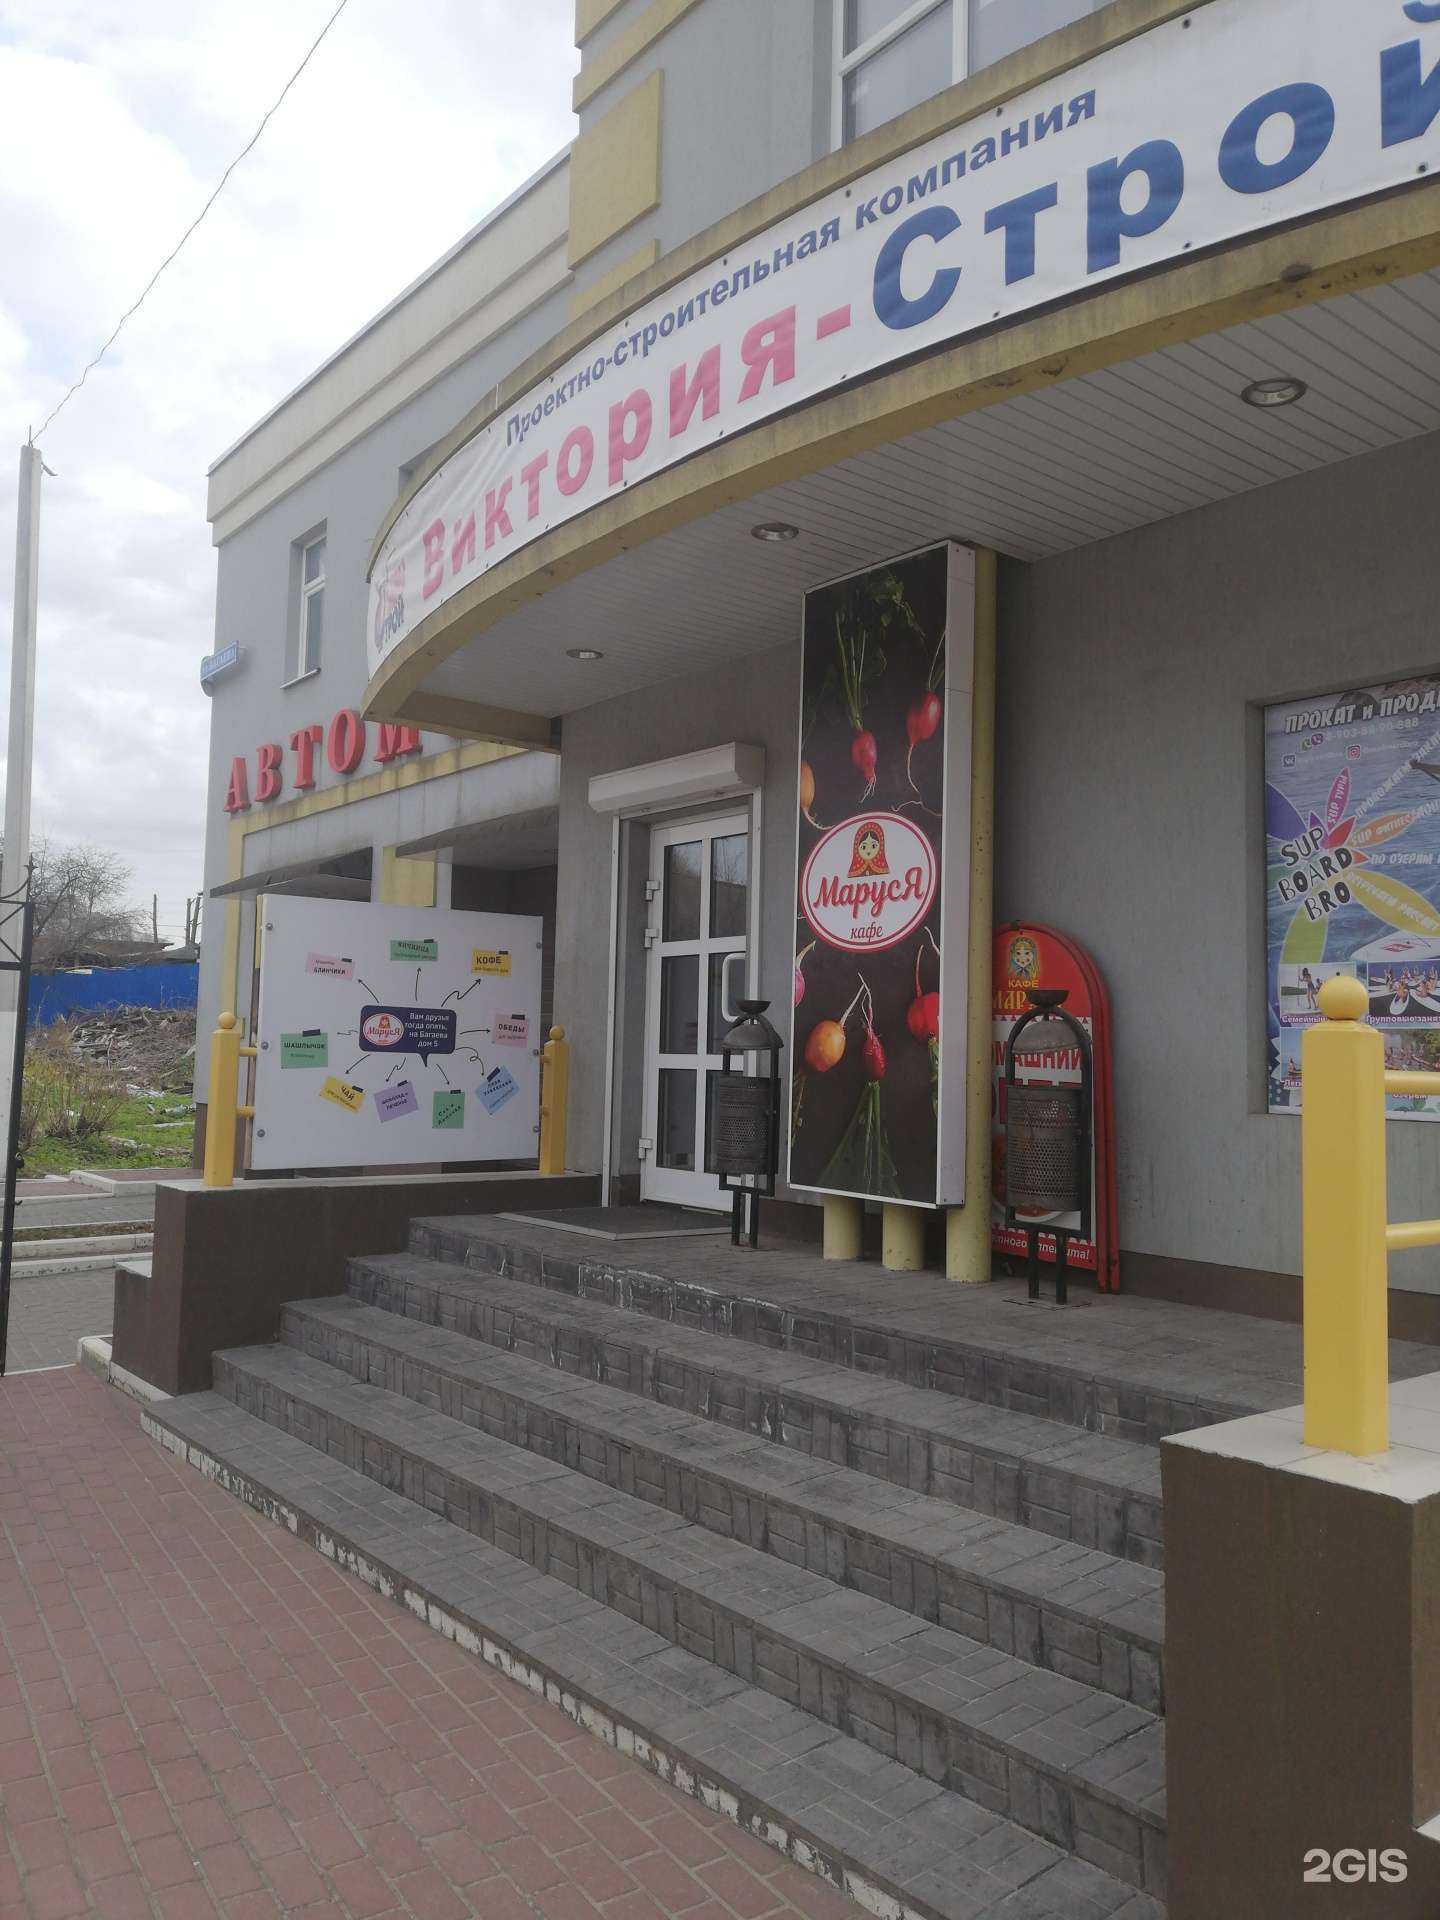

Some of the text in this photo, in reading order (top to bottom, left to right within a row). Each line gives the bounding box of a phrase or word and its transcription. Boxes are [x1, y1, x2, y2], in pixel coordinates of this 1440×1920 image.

[505, 89, 1096, 446] Проектно-строительная компания
[1285, 704, 1357, 733] ПРОКАТ
[1379, 690, 1440, 716] ПРОД
[1280, 827, 1324, 867] SUP
[1278, 847, 1353, 901] BOARD
[1304, 881, 1351, 921] BRO
[850, 921, 884, 942] кафе
[476, 956, 502, 965] КОФЕ
[1008, 978, 1039, 988] КАФЕ
[498, 1023, 526, 1033] ОБЕДЫ
